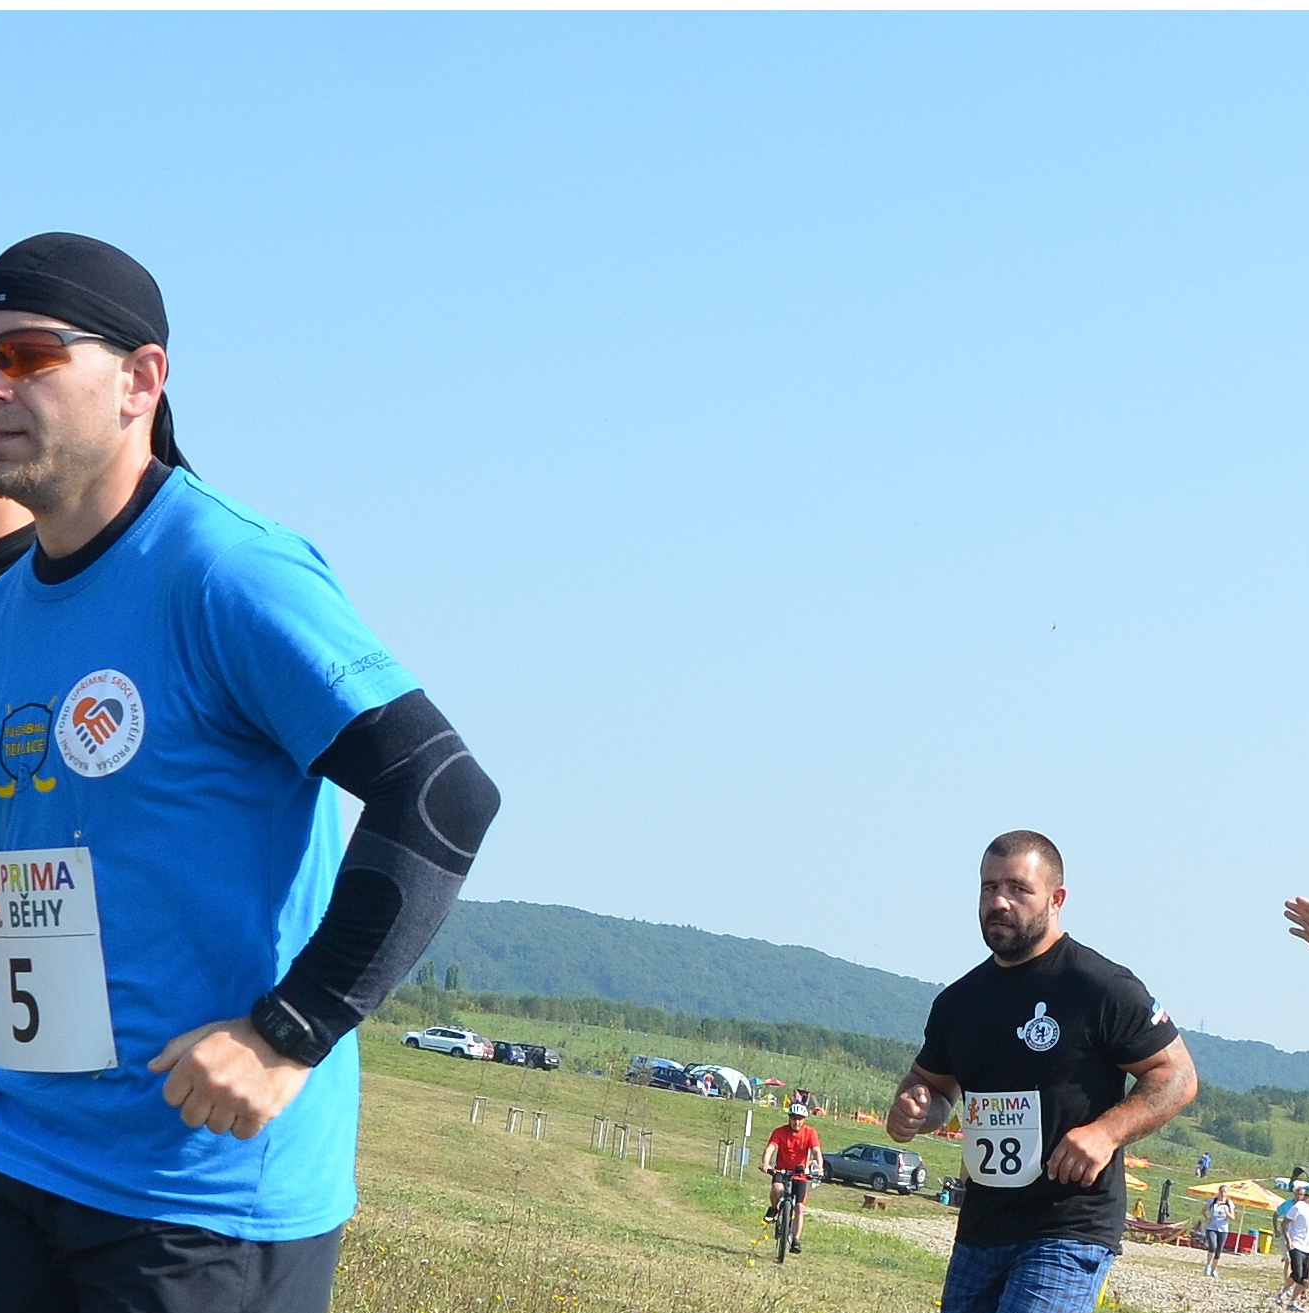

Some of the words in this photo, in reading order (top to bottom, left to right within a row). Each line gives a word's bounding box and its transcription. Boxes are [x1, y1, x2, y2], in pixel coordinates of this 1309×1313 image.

[0, 861, 75, 893] PRIMA
[9, 893, 63, 928] BĚHY
[9, 957, 40, 1043] 5
[981, 1096, 1031, 1112] PRIMA
[975, 1137, 1022, 1176] 28
